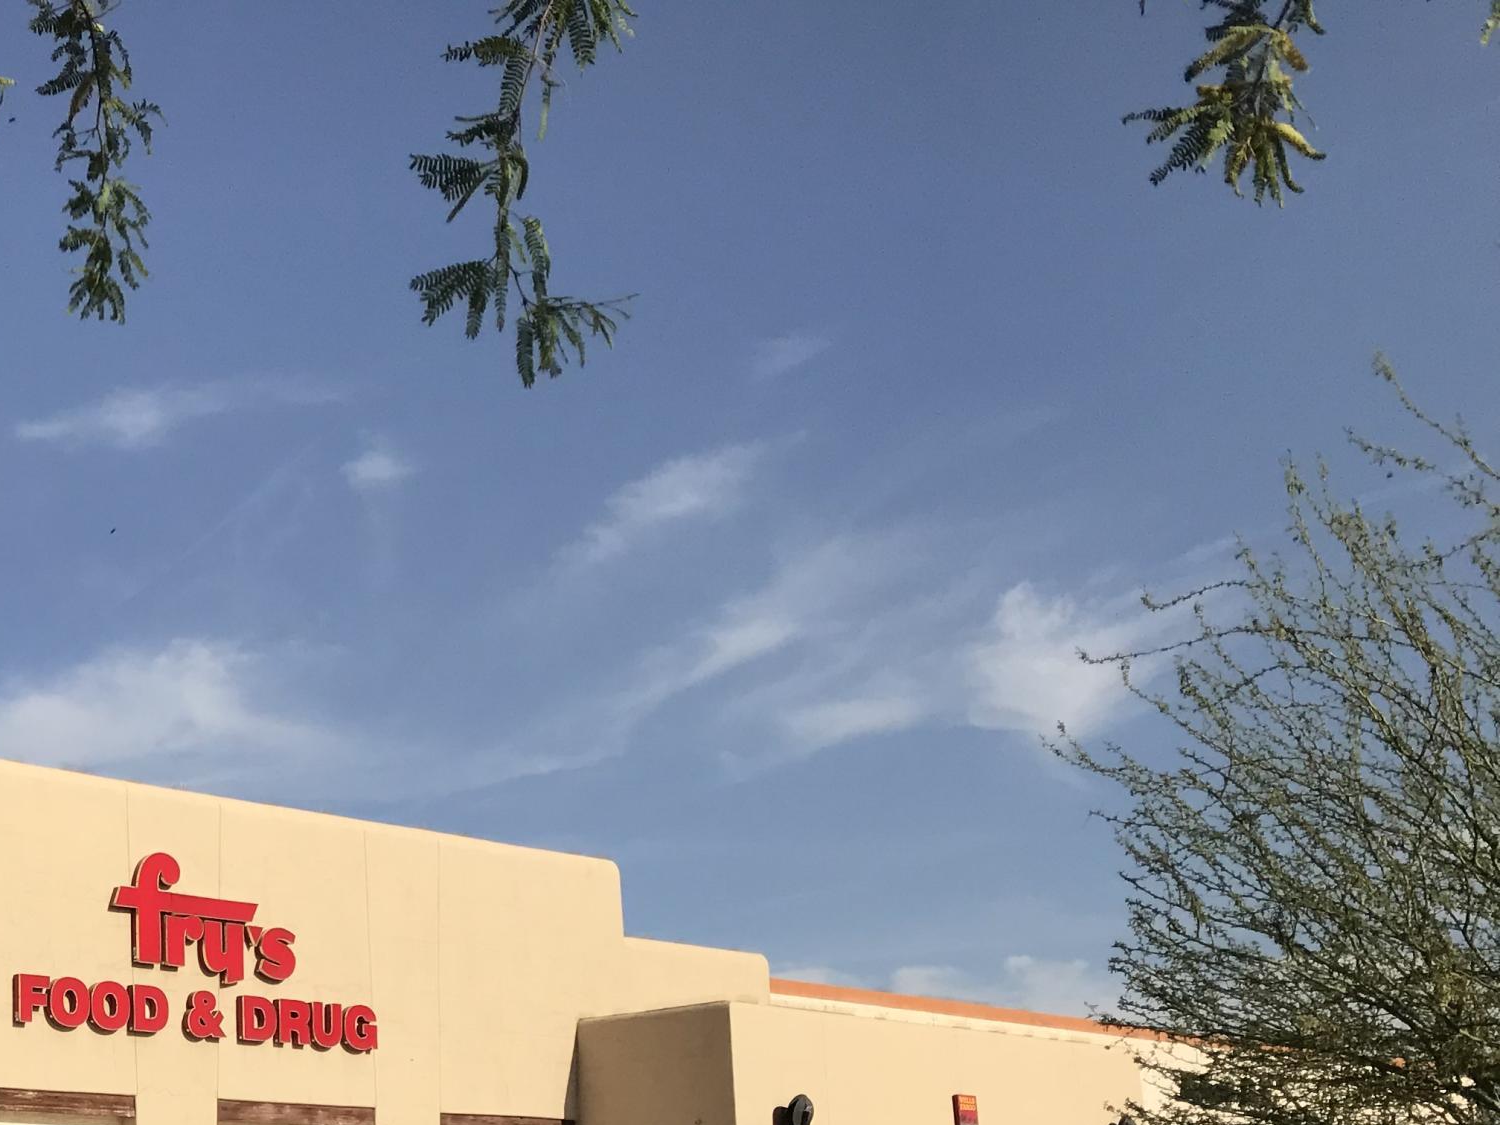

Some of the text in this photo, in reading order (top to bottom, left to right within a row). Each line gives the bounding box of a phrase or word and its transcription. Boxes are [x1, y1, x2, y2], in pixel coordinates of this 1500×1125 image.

[13, 973, 379, 1054] FOOD & DRUG
